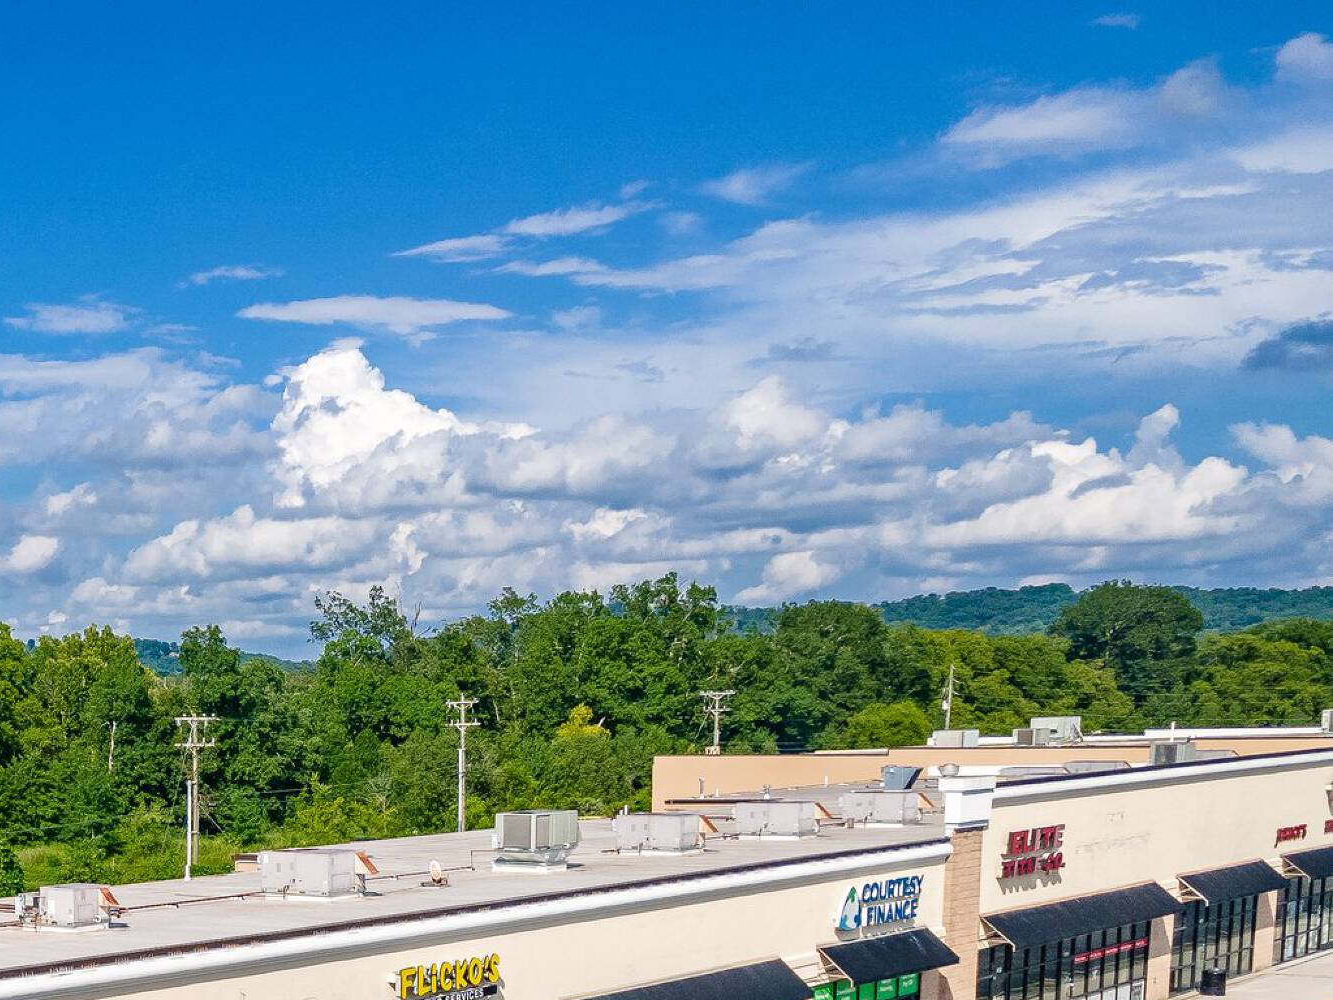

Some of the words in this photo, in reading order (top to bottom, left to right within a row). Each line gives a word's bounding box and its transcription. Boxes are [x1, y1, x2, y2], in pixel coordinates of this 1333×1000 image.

[1007, 823, 1065, 856] ELITE
[861, 874, 925, 903] COURTESY
[866, 898, 920, 926] FINANCE
